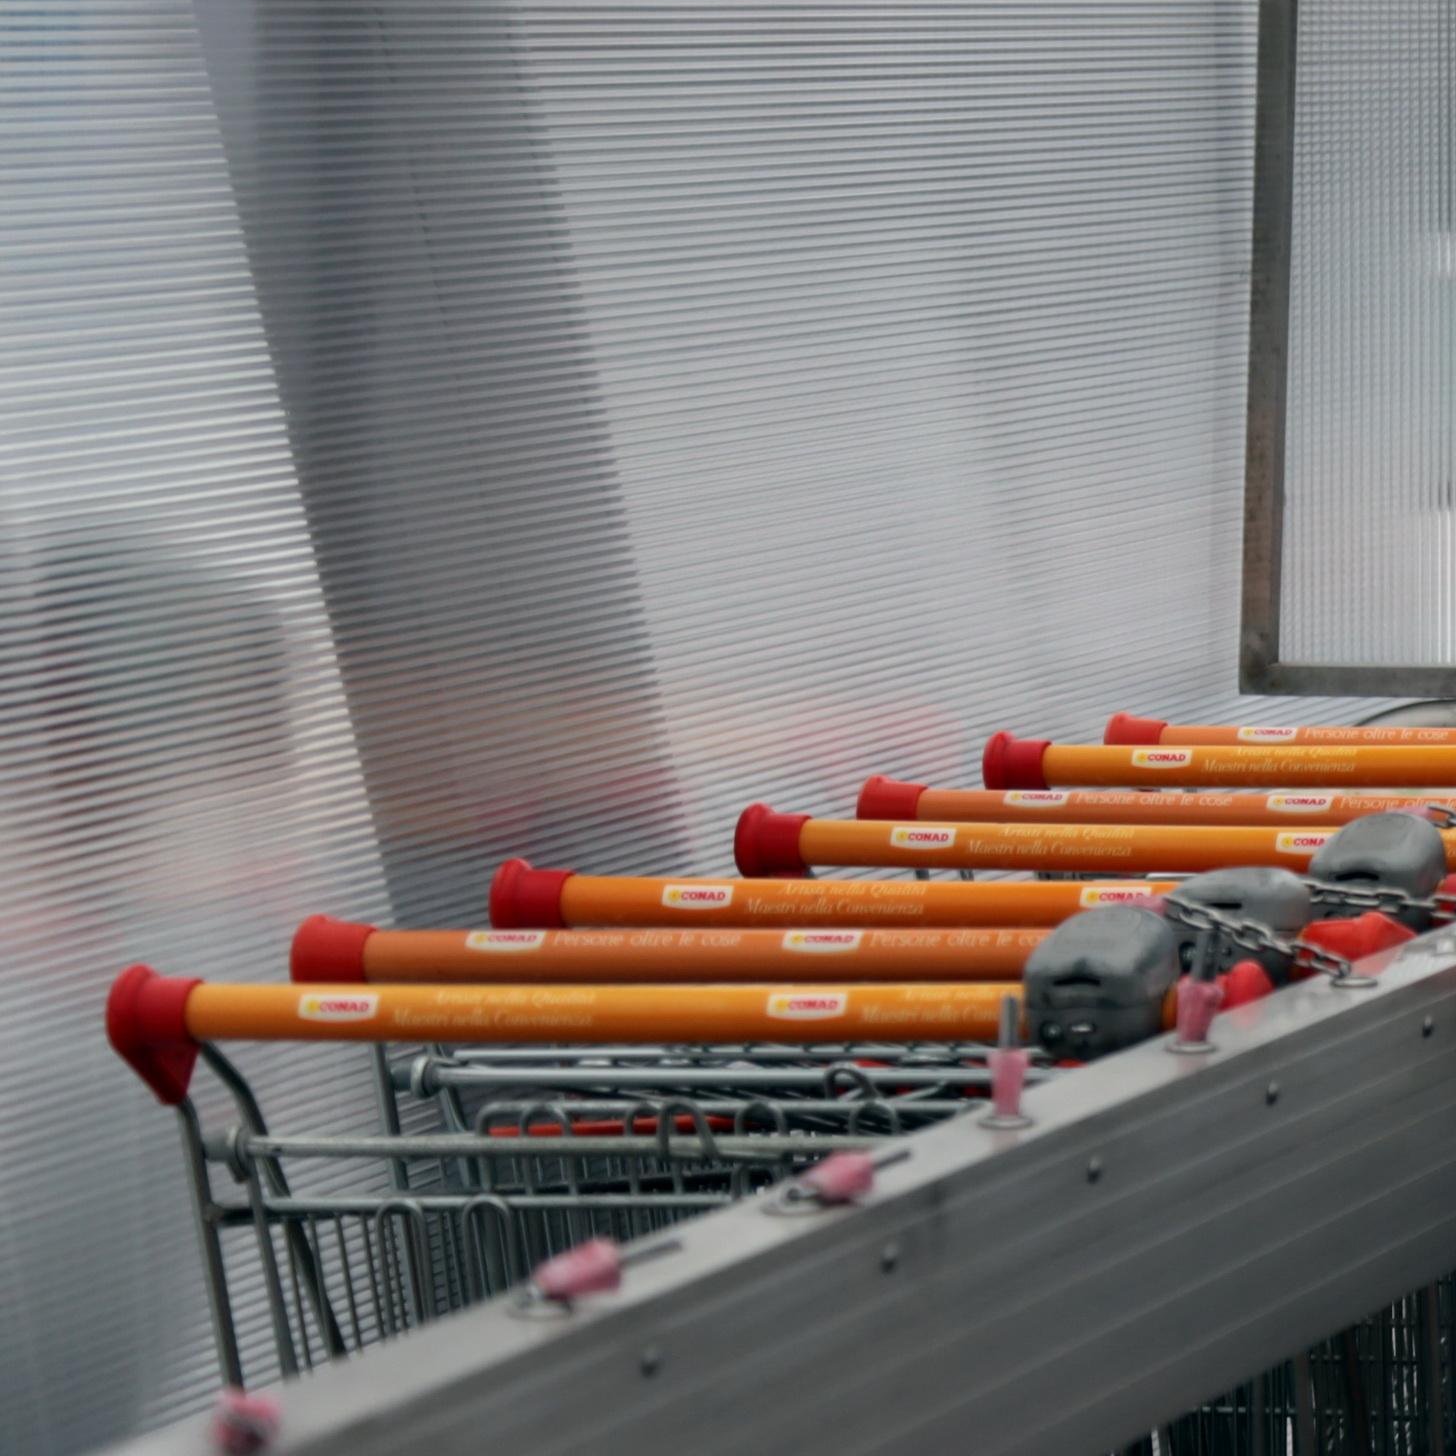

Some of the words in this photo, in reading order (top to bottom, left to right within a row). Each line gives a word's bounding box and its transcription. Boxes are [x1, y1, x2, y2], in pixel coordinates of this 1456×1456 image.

[1147, 753, 1187, 761] CONAD
[1285, 797, 1327, 806] CONAD
[907, 832, 949, 842] CONAD
[680, 890, 726, 902] CONAD
[744, 898, 796, 915] Maestri
[800, 897, 832, 914] nella
[836, 898, 924, 915] Convenienza
[318, 1000, 369, 1013] CONAD
[788, 998, 838, 1011] CONAD
